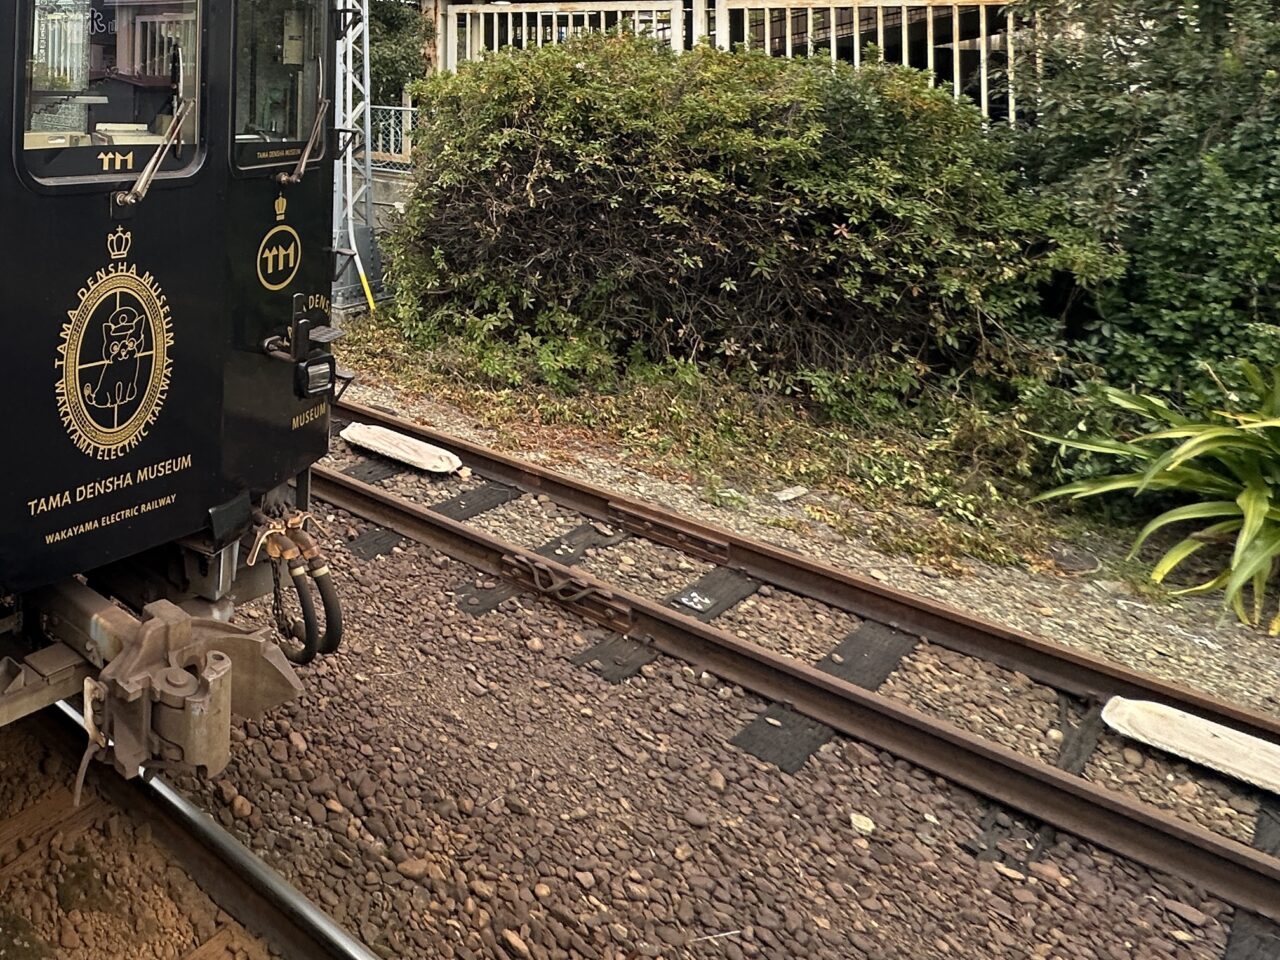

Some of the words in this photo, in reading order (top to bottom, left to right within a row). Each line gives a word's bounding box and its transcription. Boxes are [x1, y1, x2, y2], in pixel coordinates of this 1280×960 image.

[97, 151, 133, 171] TM
[262, 241, 295, 274] TM
[55, 309, 78, 369] TAMA
[77, 261, 137, 300] DENSHA
[142, 271, 175, 346] MUSEUM
[308, 293, 331, 319] DENS
[55, 379, 93, 457] WAKAYAMA
[97, 426, 149, 461] ELECTRIC
[149, 357, 174, 426] RAILWAY
[292, 401, 326, 431] MUSEUM
[27, 491, 71, 516] TAMA
[76, 472, 133, 502] DENSHA
[136, 454, 192, 484] MUSEUM
[45, 519, 99, 544] WAKAYAMA
[101, 505, 139, 527] ELECTRIC
[140, 493, 177, 513] RAILWAY
